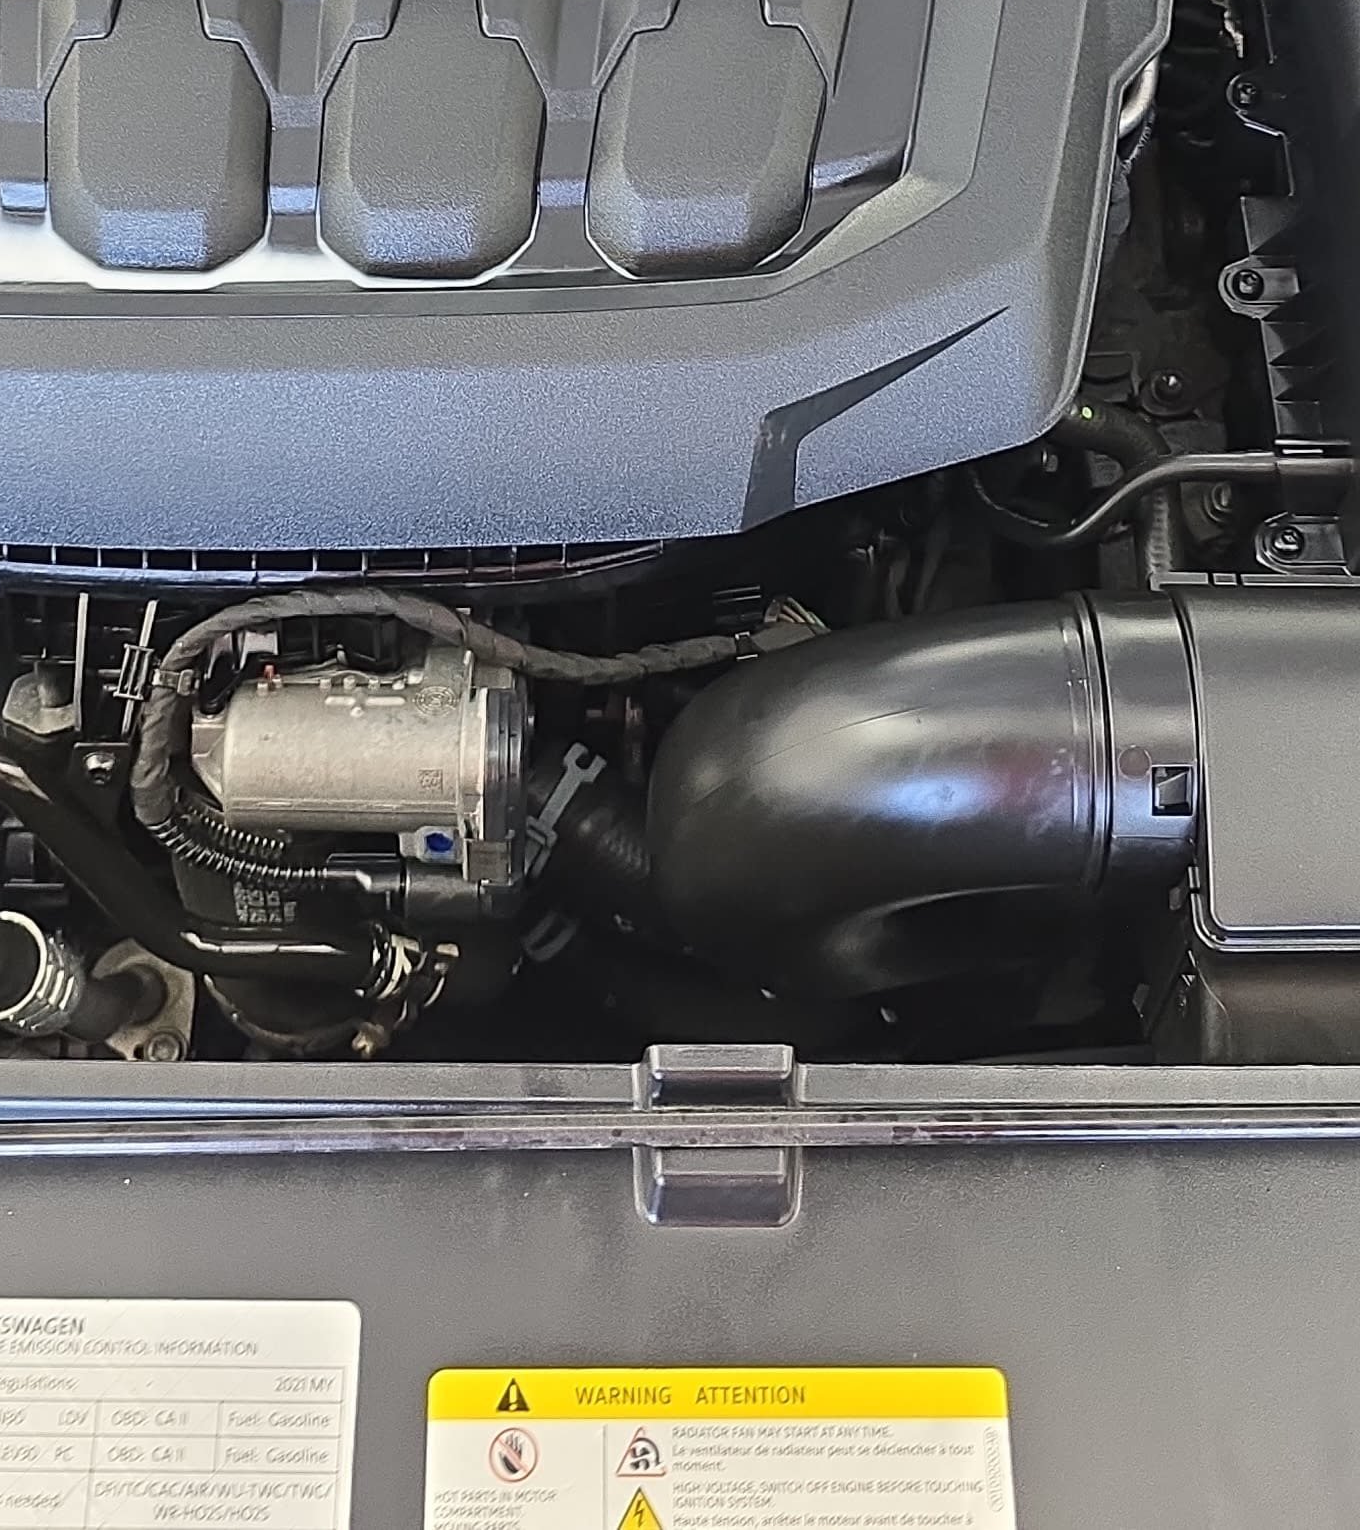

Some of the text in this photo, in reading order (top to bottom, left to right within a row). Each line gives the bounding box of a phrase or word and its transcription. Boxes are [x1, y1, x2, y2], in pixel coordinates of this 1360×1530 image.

[9, 1339, 79, 1355] EMISSION
[83, 1339, 148, 1356] CONTROL
[154, 1340, 258, 1356] INFORMATION
[575, 1386, 806, 1406] WARNING ATTENTION
[268, 1412, 332, 1428] Gasoline
[672, 1426, 730, 1439] RADIATOR
[732, 1426, 754, 1439] FAN
[757, 1426, 781, 1439] MAY
[783, 1426, 819, 1439] START
[266, 1447, 330, 1464] Gasoline
[690, 1444, 752, 1457] ventilateur
[754, 1444, 770, 1457] de
